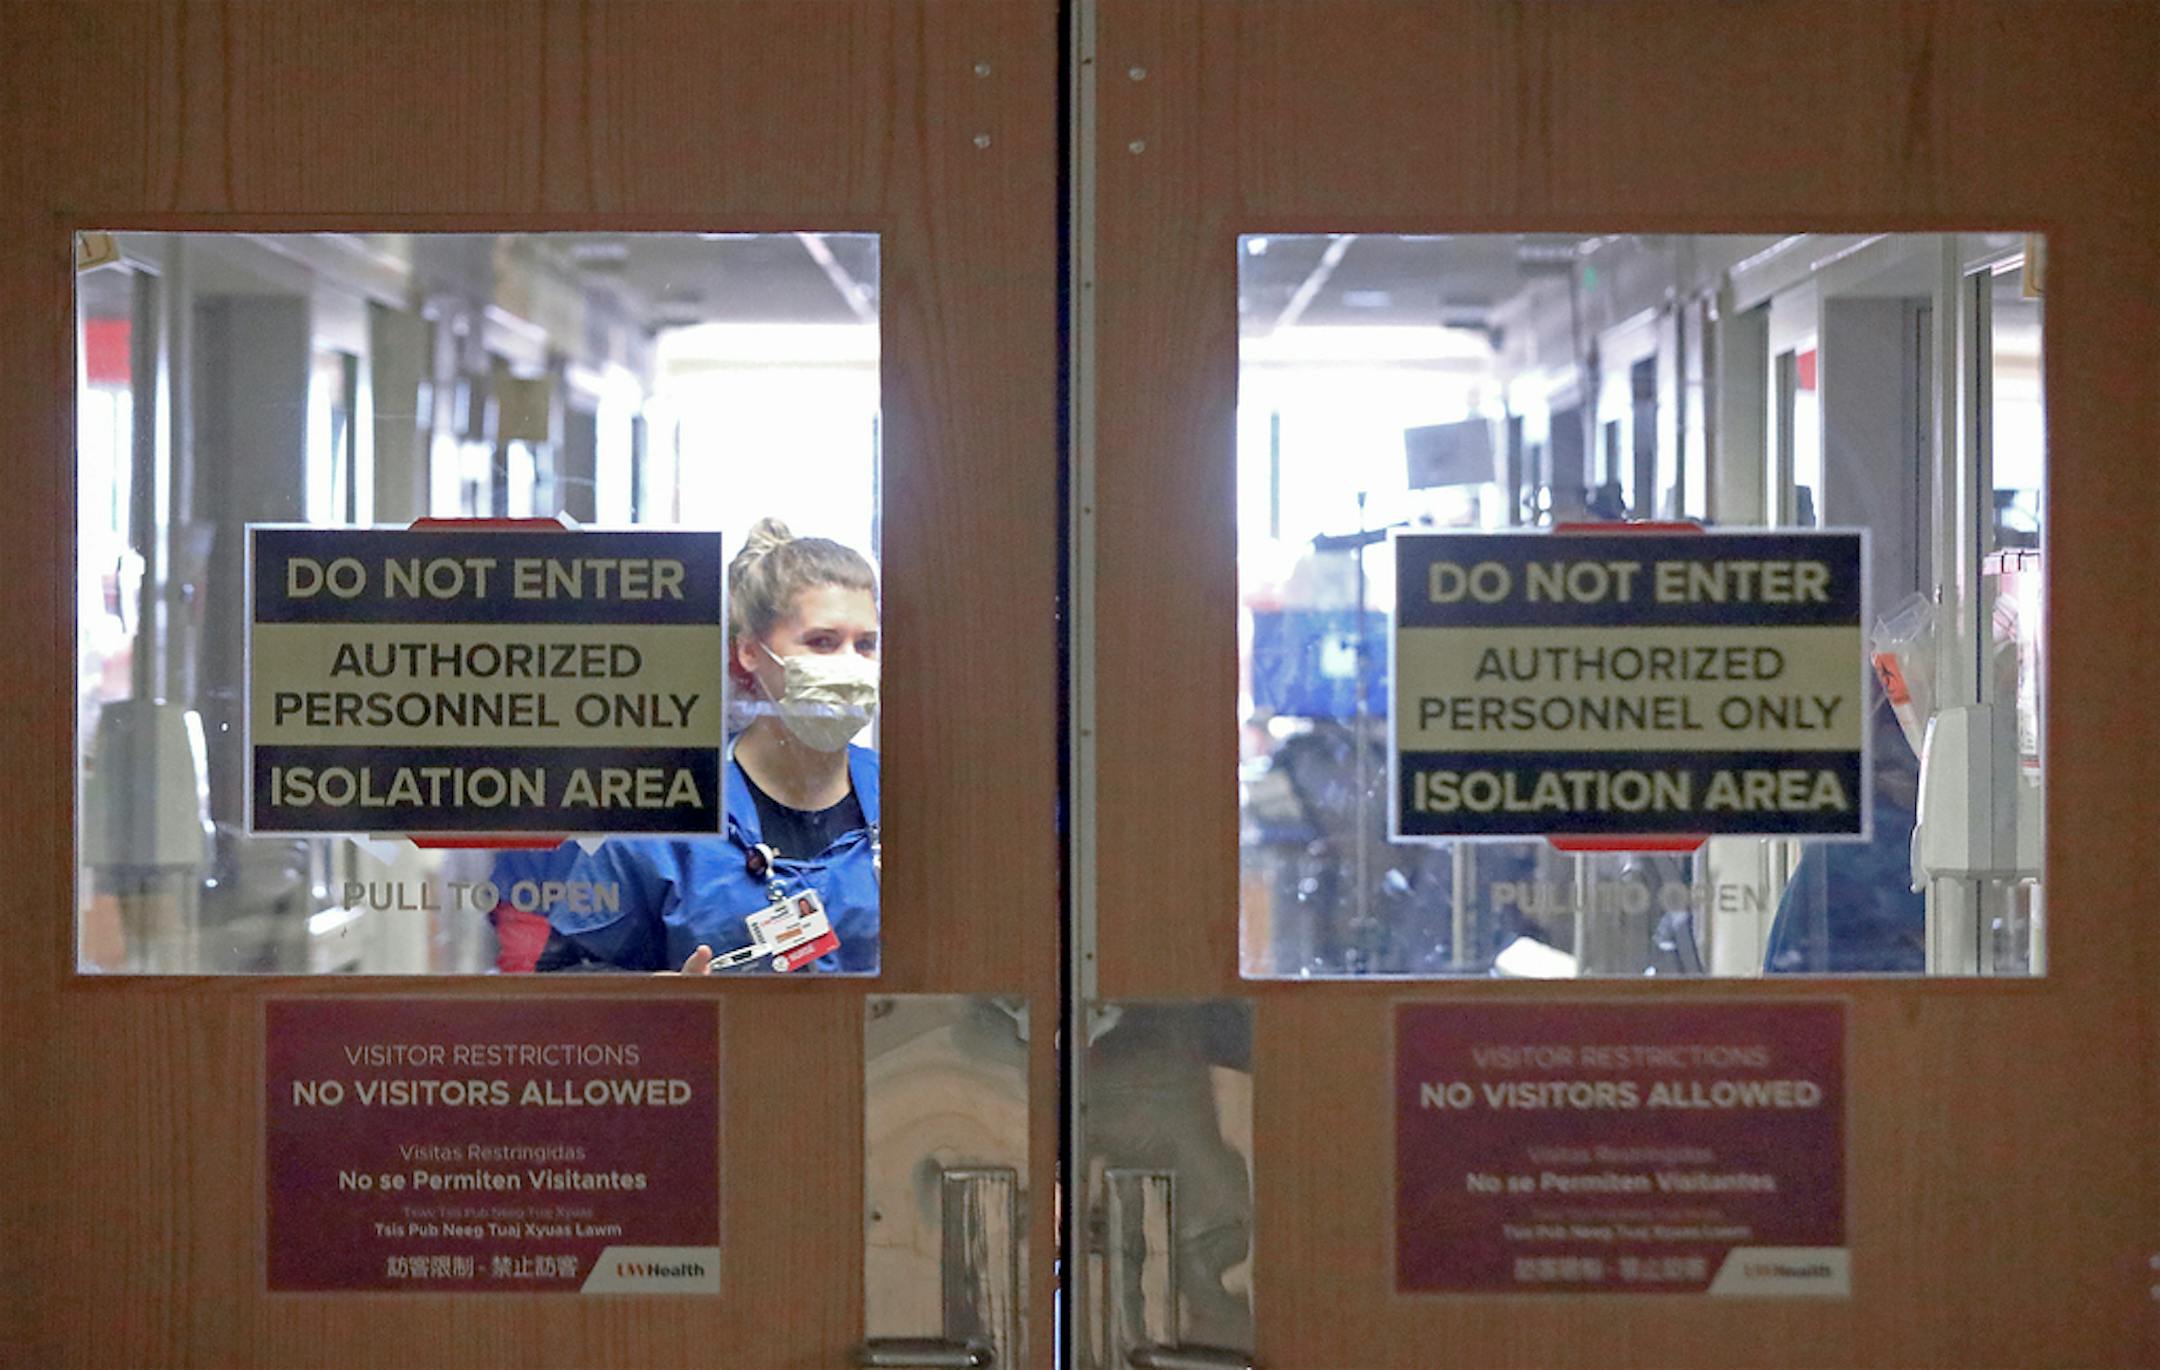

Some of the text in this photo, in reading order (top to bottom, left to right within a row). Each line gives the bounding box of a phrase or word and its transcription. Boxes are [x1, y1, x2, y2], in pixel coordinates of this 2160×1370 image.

[287, 558, 685, 601] DO NOT ENTER
[1429, 562, 1829, 604] DO NOT ENTER
[330, 642, 643, 677] AUTHORIZED
[1475, 647, 1784, 682] AUTHORIZED
[275, 692, 700, 728] PERSONNEL ONLY
[1419, 696, 1842, 731] PERSONNEL ONLY
[271, 766, 703, 808] ISOLATION AREA
[1414, 771, 1847, 812] ISOLATION AREA
[343, 881, 620, 914] PULL TO OPEN
[343, 1045, 640, 1066] VISITOR RESTRICTIONS
[1473, 1046, 1770, 1069] VISITOR RESTRICTIONS
[293, 1079, 692, 1106] NO VISITORS ALLOWED
[1420, 1081, 1822, 1109] NO VISITORS ALLOWED
[400, 1144, 586, 1164] Visitas Restringidas
[339, 1169, 647, 1190] No se Permiten Visitantes
[408, 1222, 439, 1236] Pub
[575, 1222, 622, 1236] Lawm
